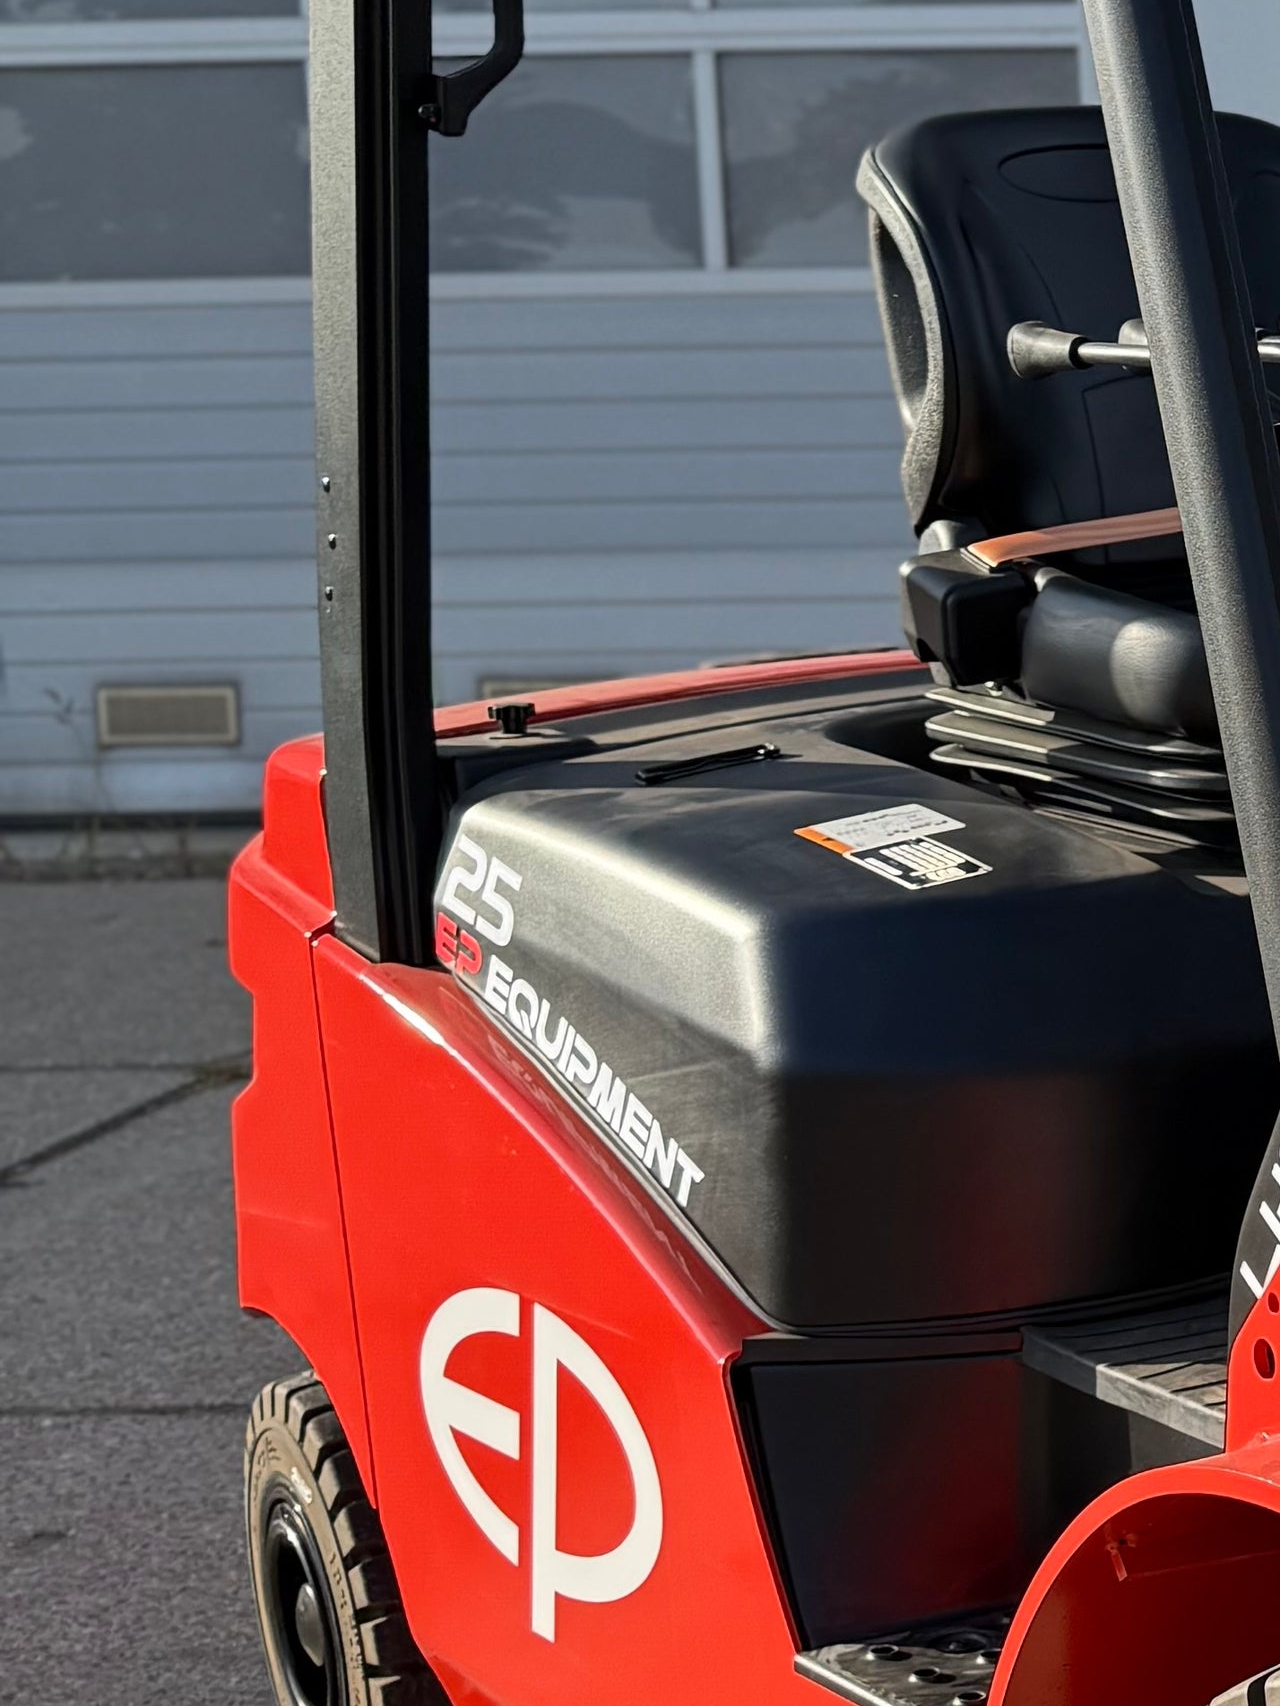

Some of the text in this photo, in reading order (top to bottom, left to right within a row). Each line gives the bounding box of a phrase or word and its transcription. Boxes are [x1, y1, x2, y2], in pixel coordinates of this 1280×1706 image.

[440, 838, 523, 948] 25
[434, 911, 706, 1209] EP EQUIPMENT
[419, 1285, 663, 1643] EP
